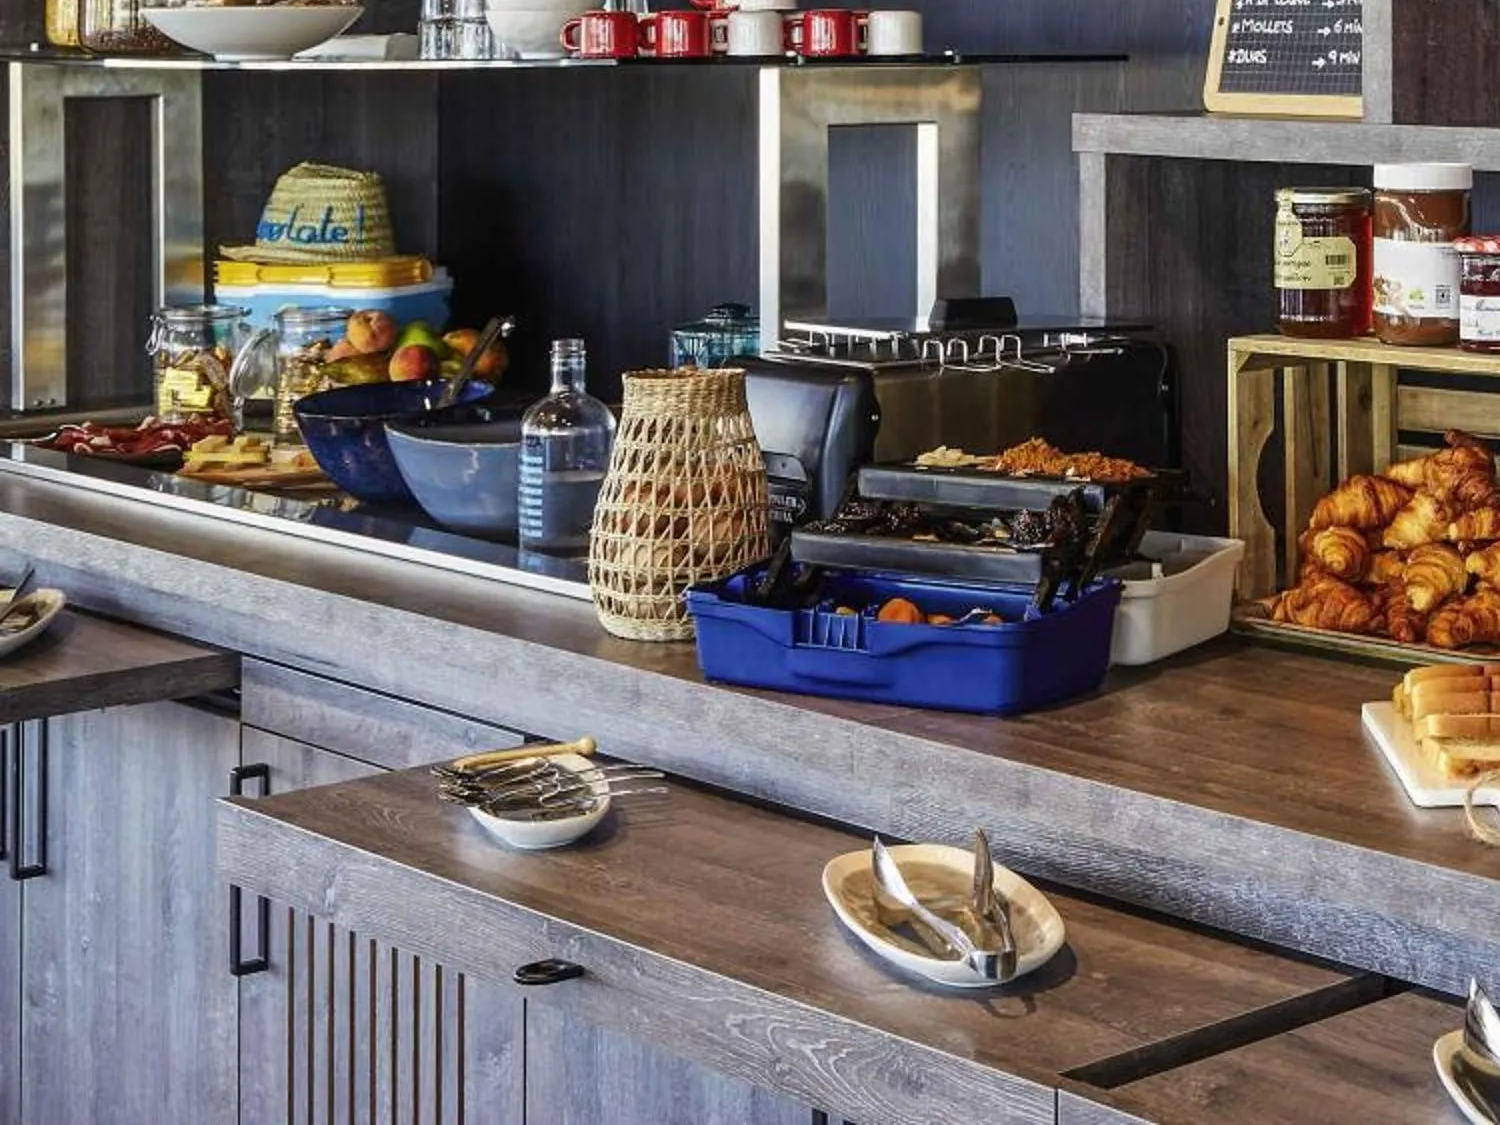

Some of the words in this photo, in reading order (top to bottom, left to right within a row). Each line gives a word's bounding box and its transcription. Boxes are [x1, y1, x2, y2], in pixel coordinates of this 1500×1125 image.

[1242, 19, 1294, 34] MOLLETS
[1333, 18, 1343, 33] 6
[1328, 50, 1337, 65] 9
